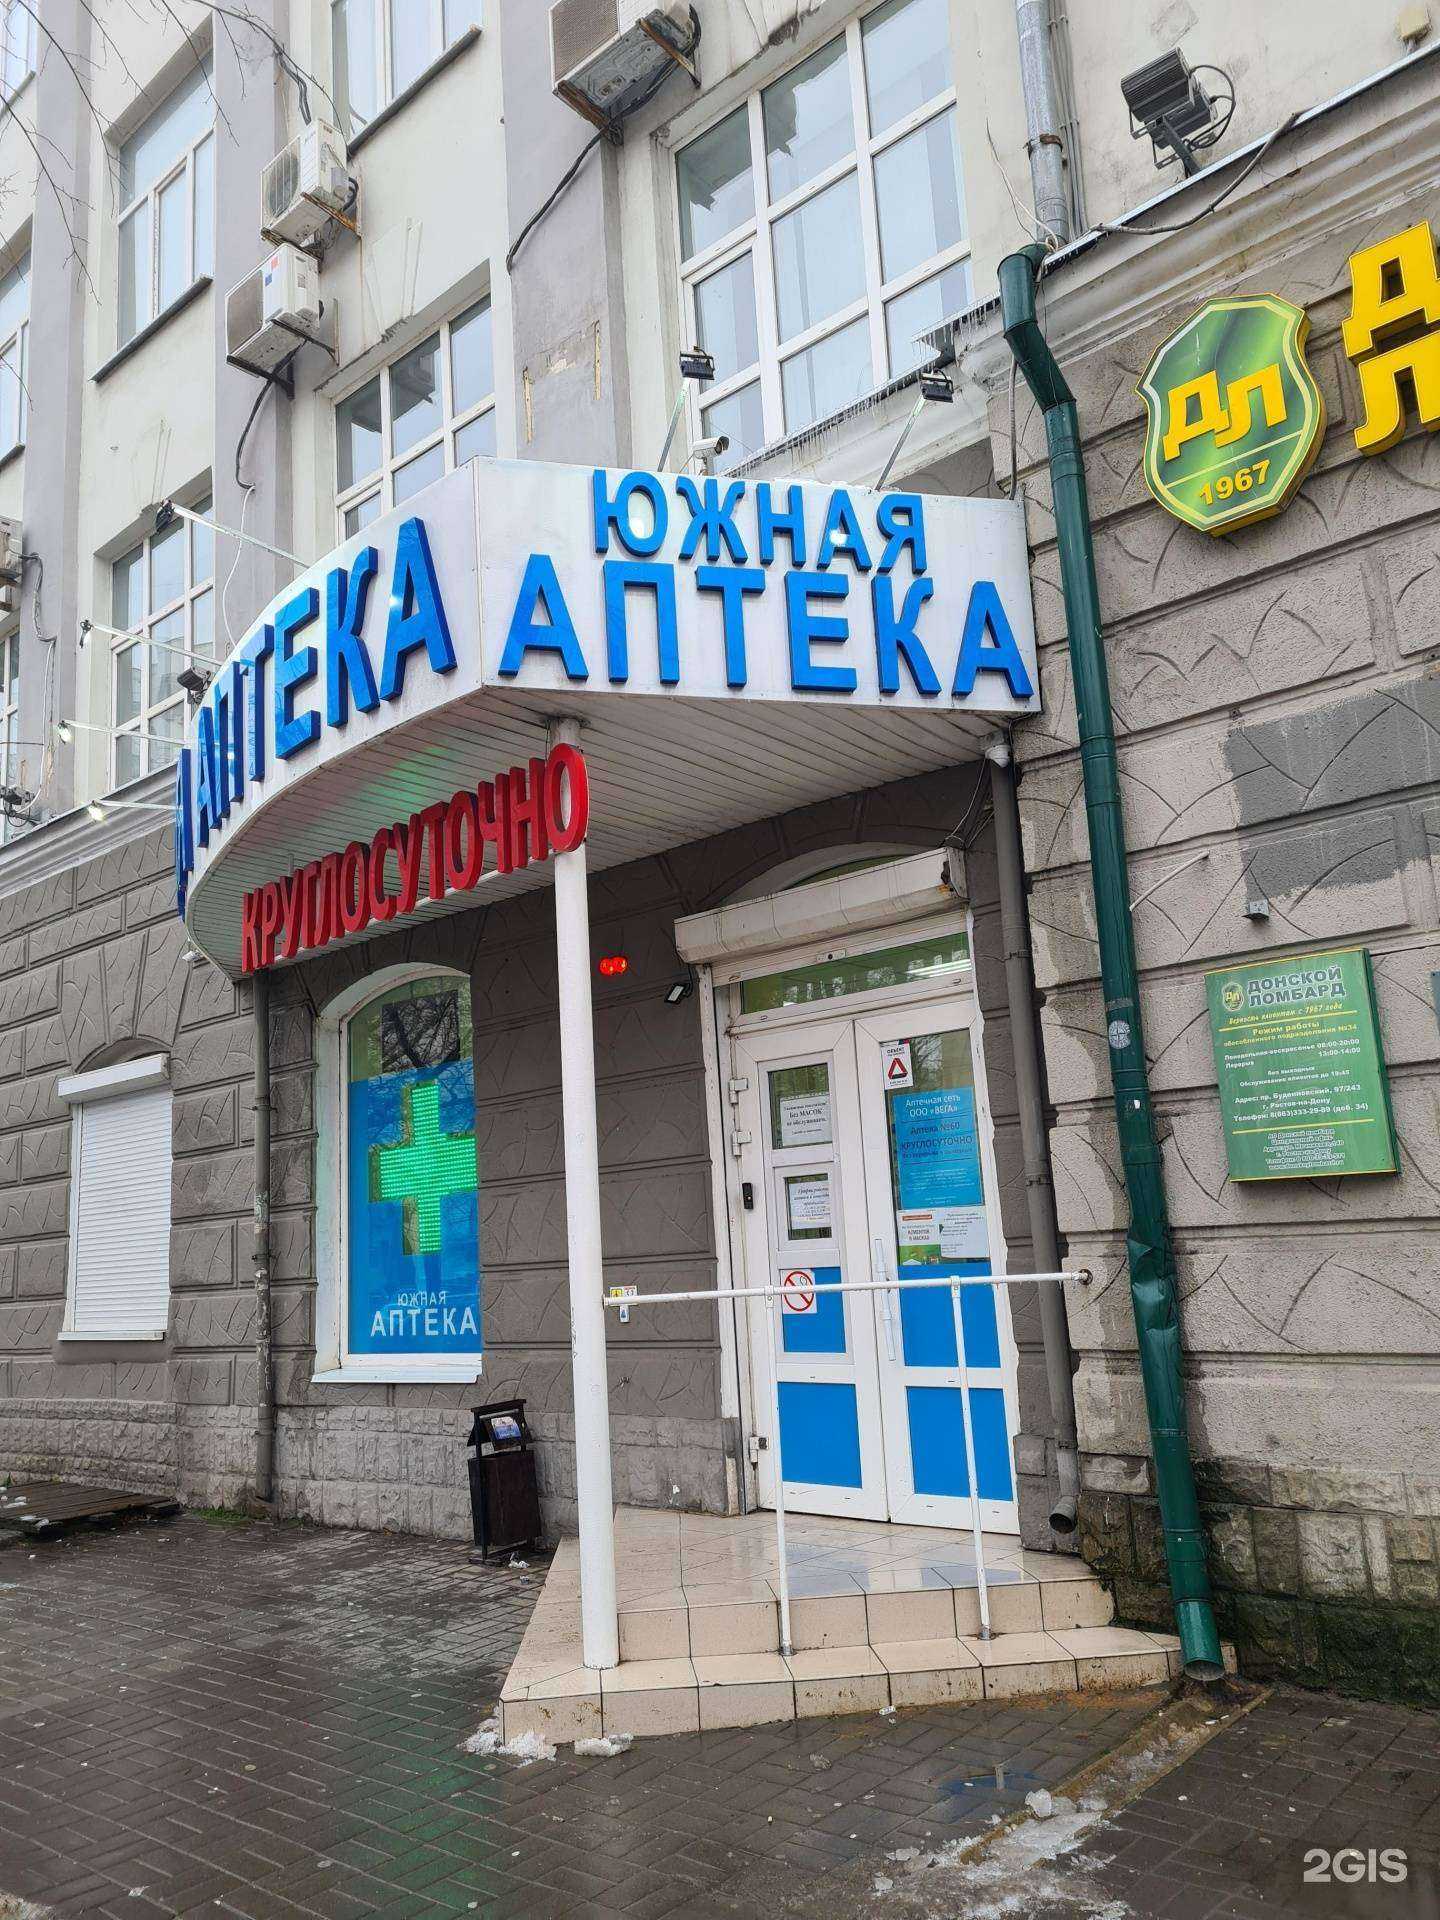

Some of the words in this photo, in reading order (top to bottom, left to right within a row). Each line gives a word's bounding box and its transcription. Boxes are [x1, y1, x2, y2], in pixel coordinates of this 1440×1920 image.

[1163, 363, 1287, 461] ДЛ
[1200, 459, 1271, 505] 1967
[593, 469, 927, 575] ЮЖНАЯ
[498, 553, 1035, 699] АПТЕКА
[197, 517, 457, 849] АПТЕКА
[242, 743, 589, 974] КРУГЛОСУТОЧНО
[1248, 966, 1342, 995] ДОНСКОЙ
[1249, 982, 1346, 1007] ЛОМБАРД
[1305, 1004, 1324, 1014] 1967
[1253, 1026, 1283, 1036] Режим
[1285, 1022, 1320, 1033] работы
[1225, 1061, 1255, 1070] Перерыв
[1318, 1046, 1361, 1057] 13:00-14:00
[1239, 1076, 1287, 1088] Обслуживание
[906, 1098, 941, 1108] Аптечная
[943, 1095, 961, 1103] сеть
[1234, 1096, 1259, 1105] Адрес:
[1333, 1084, 1361, 1093] 97/243
[1270, 1097, 1331, 1110] Ростов-на-Дону
[909, 1107, 928, 1118] ООО
[1234, 1113, 1270, 1123] Телефон:
[1333, 1104, 1353, 1114] (доб.
[1355, 1103, 1369, 1111] 34)
[911, 1126, 939, 1135] Аптека
[902, 1136, 973, 1151] КРУГЛОСУТОЧНО
[397, 1290, 447, 1306] ЮЖНАЯ
[370, 1306, 478, 1337] АПТЕКА
